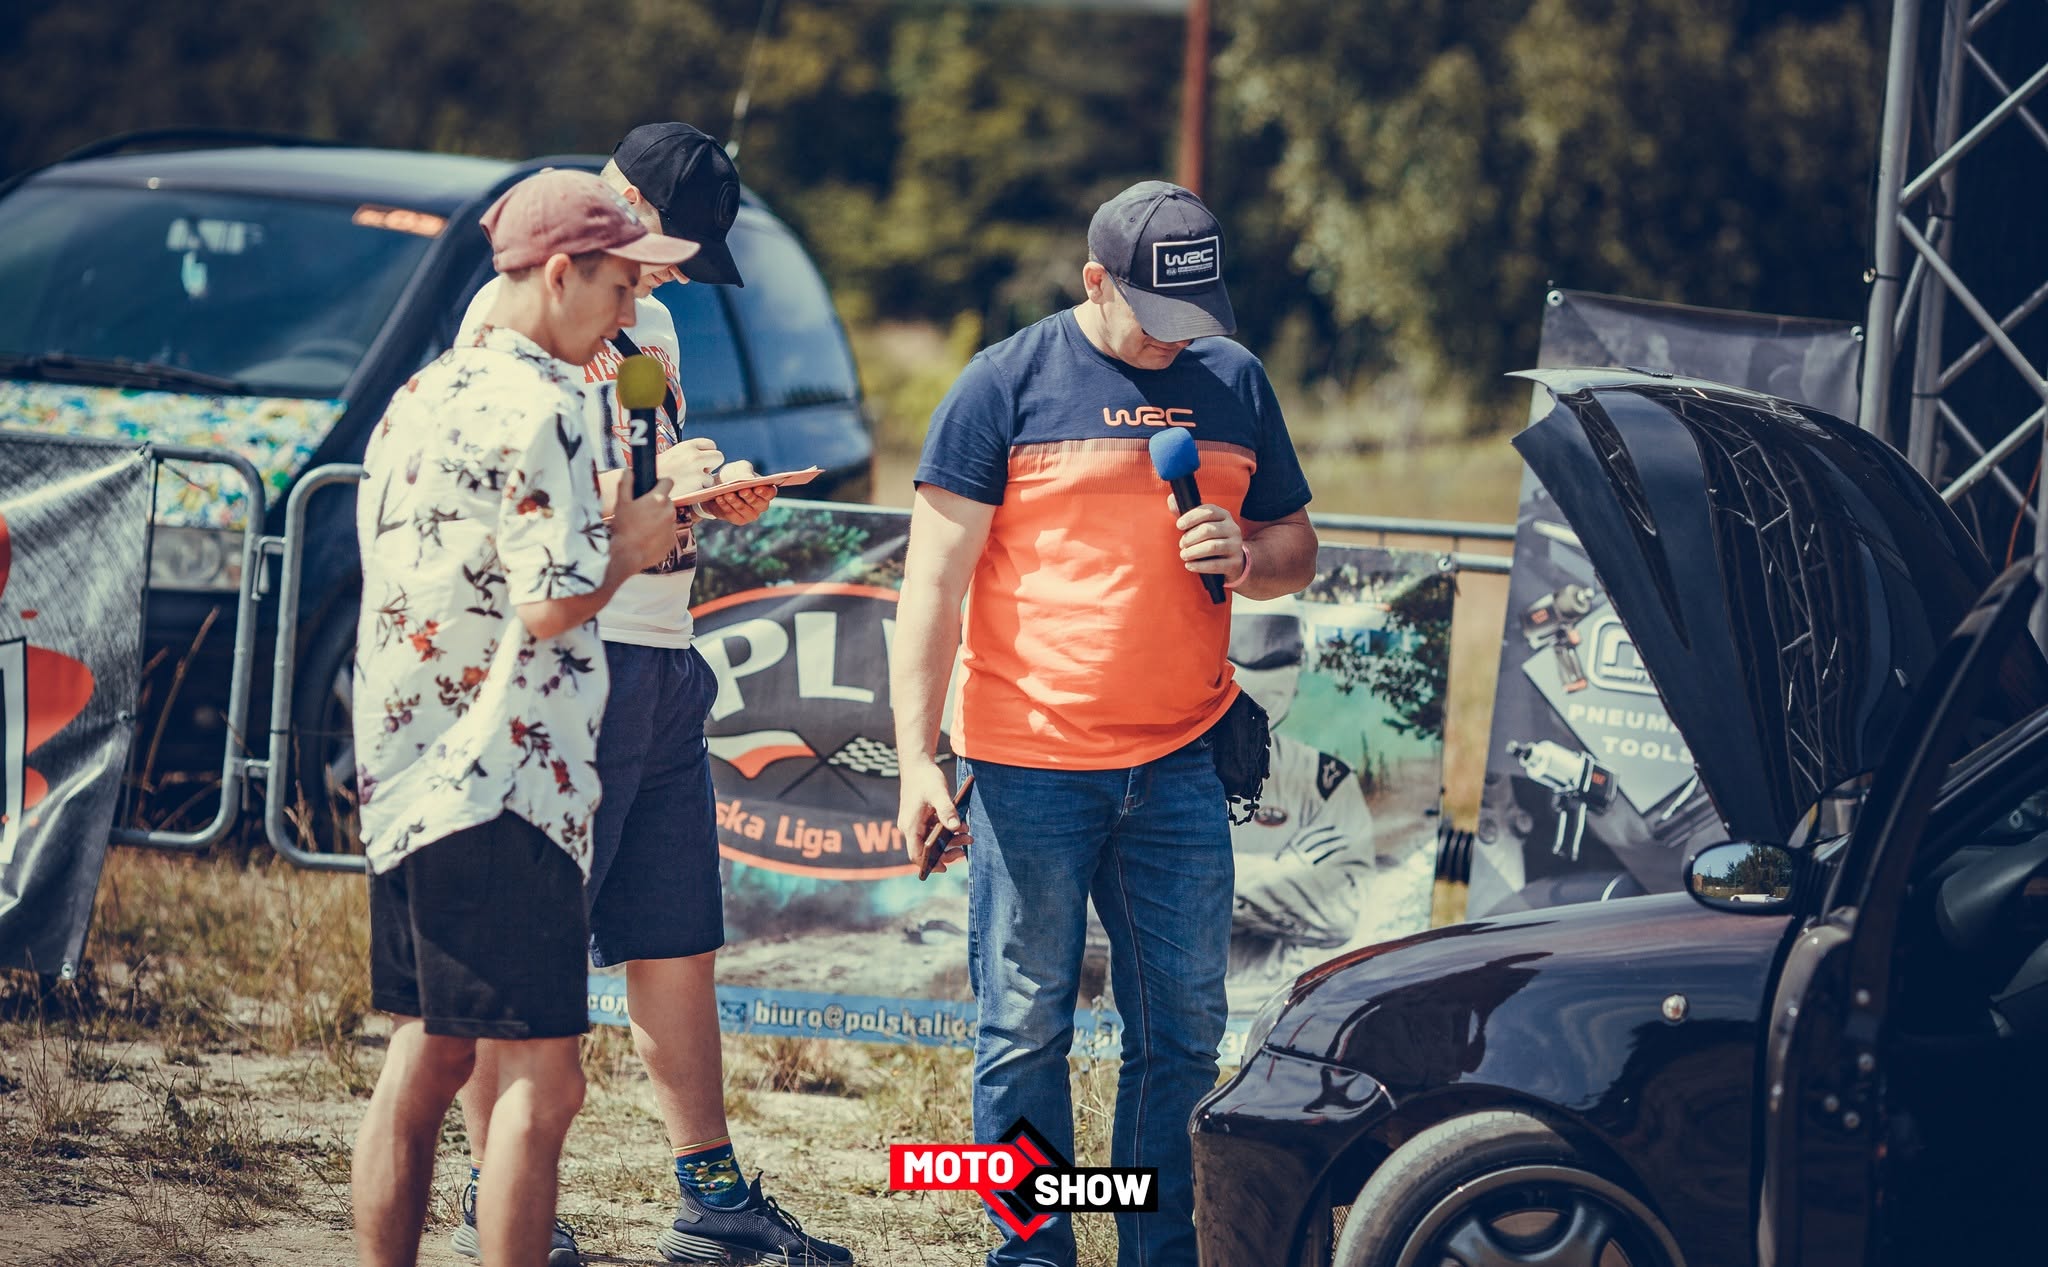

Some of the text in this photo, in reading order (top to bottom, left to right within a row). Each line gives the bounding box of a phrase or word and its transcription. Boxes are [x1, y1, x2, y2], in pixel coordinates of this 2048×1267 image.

[1164, 248, 1214, 266] WRC
[1103, 406, 1197, 427] WRC
[629, 419, 649, 446] 2
[716, 799, 904, 859] ska Liga Wr
